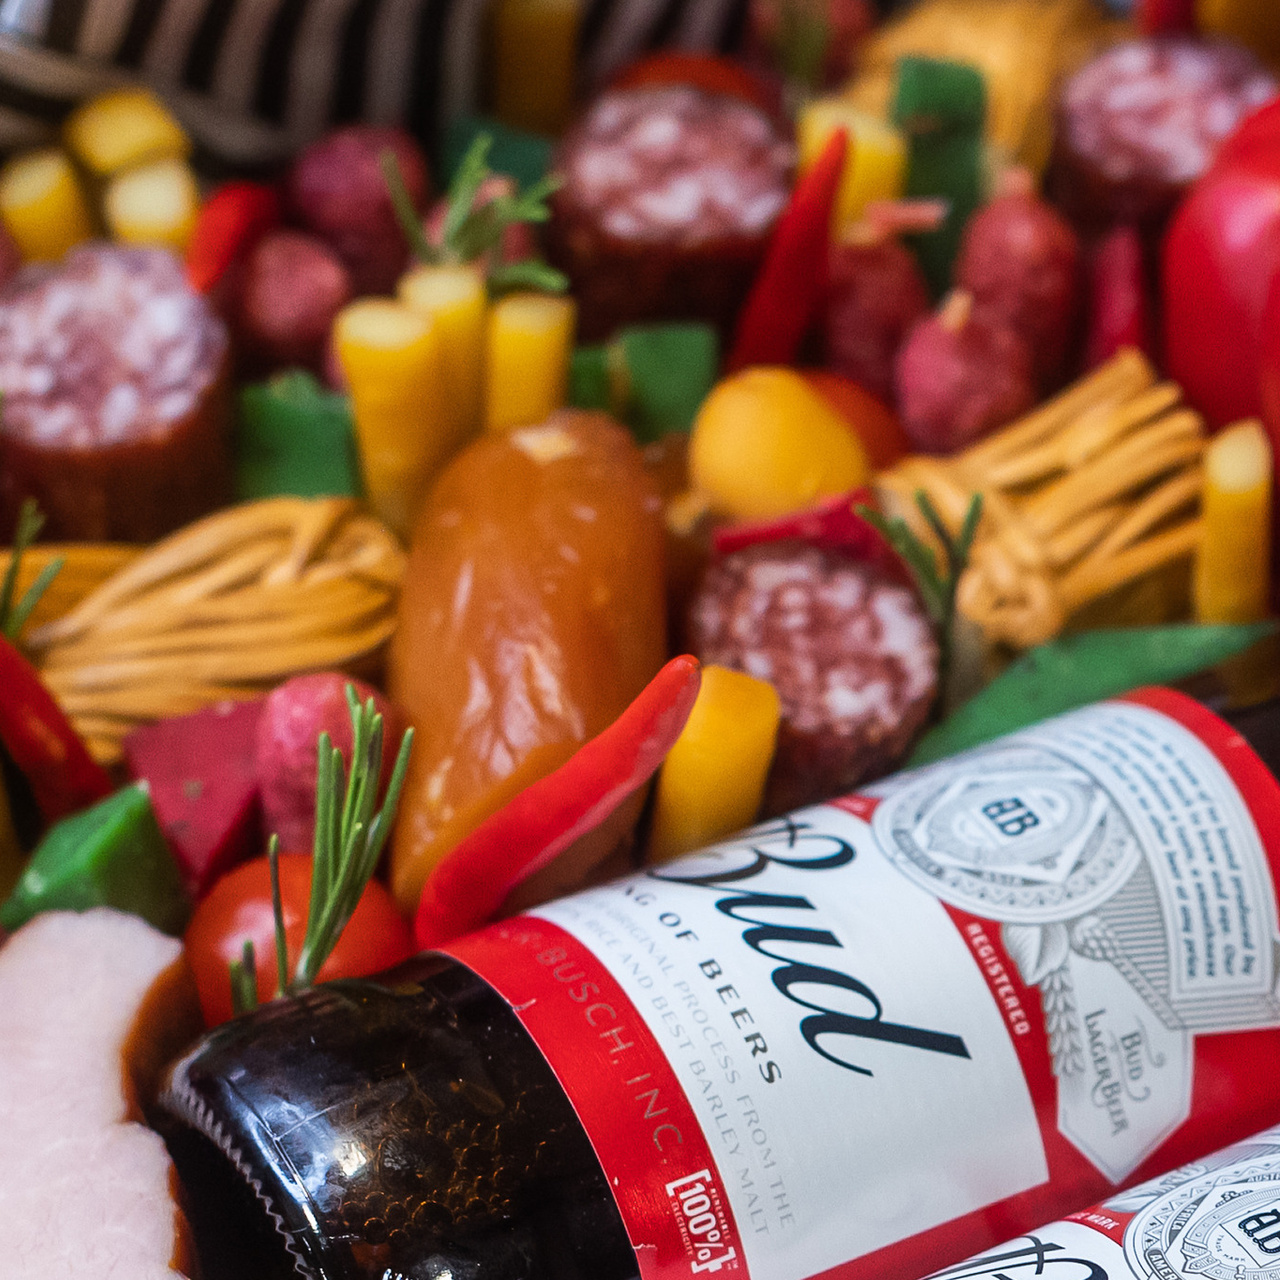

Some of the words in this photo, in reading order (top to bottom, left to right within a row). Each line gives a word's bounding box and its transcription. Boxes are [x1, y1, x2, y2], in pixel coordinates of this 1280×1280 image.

[645, 815, 973, 1077] Bud
[658, 911, 699, 944] OF
[698, 958, 783, 1085] BEERS
[967, 922, 1031, 1036] REGISTERED
[619, 952, 654, 989] AND
[651, 996, 695, 1051] BEST
[689, 1060, 744, 1155] BARLEY
[739, 1168, 770, 1235] MALT
[626, 1073, 682, 1164] INC.
[673, 980, 741, 1084] PROCESS
[736, 1094, 776, 1169] FROM
[769, 1176, 795, 1229] THE
